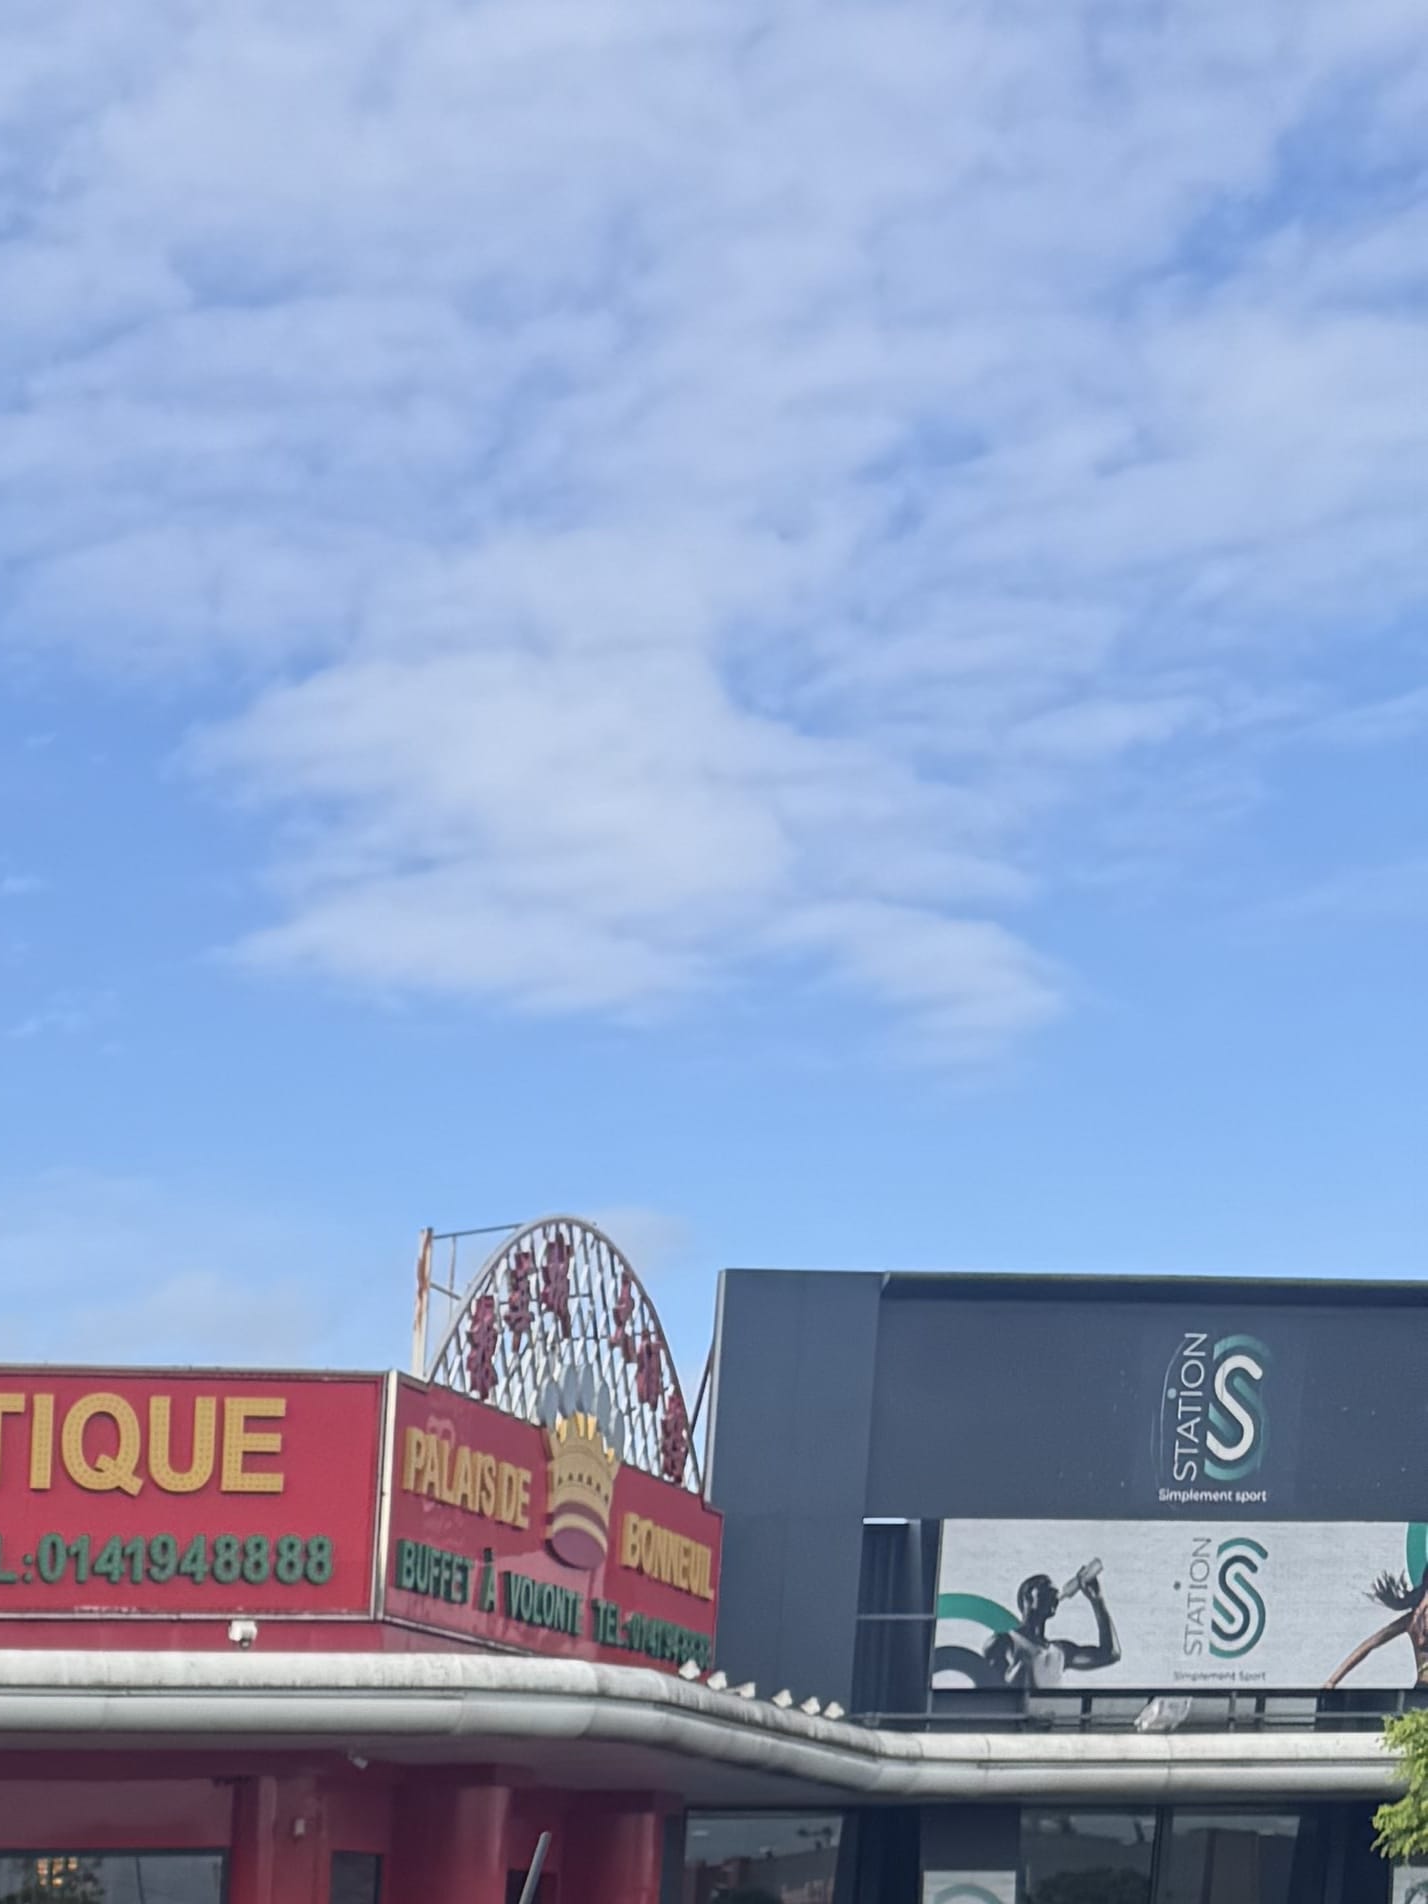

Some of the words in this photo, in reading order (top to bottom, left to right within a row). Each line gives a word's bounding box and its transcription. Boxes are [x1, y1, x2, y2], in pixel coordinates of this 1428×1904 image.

[1173, 1332, 1208, 1481] STATION
[402, 1427, 496, 1518] PALAIS
[495, 1460, 533, 1530] DE
[620, 1512, 714, 1601] BONNEUIL
[1158, 1487, 1233, 1504] Simplement
[1235, 1489, 1268, 1504] sport
[396, 1539, 474, 1606] BUFFET
[501, 1570, 584, 1637] VOLONTE
[1184, 1537, 1211, 1656] STATION
